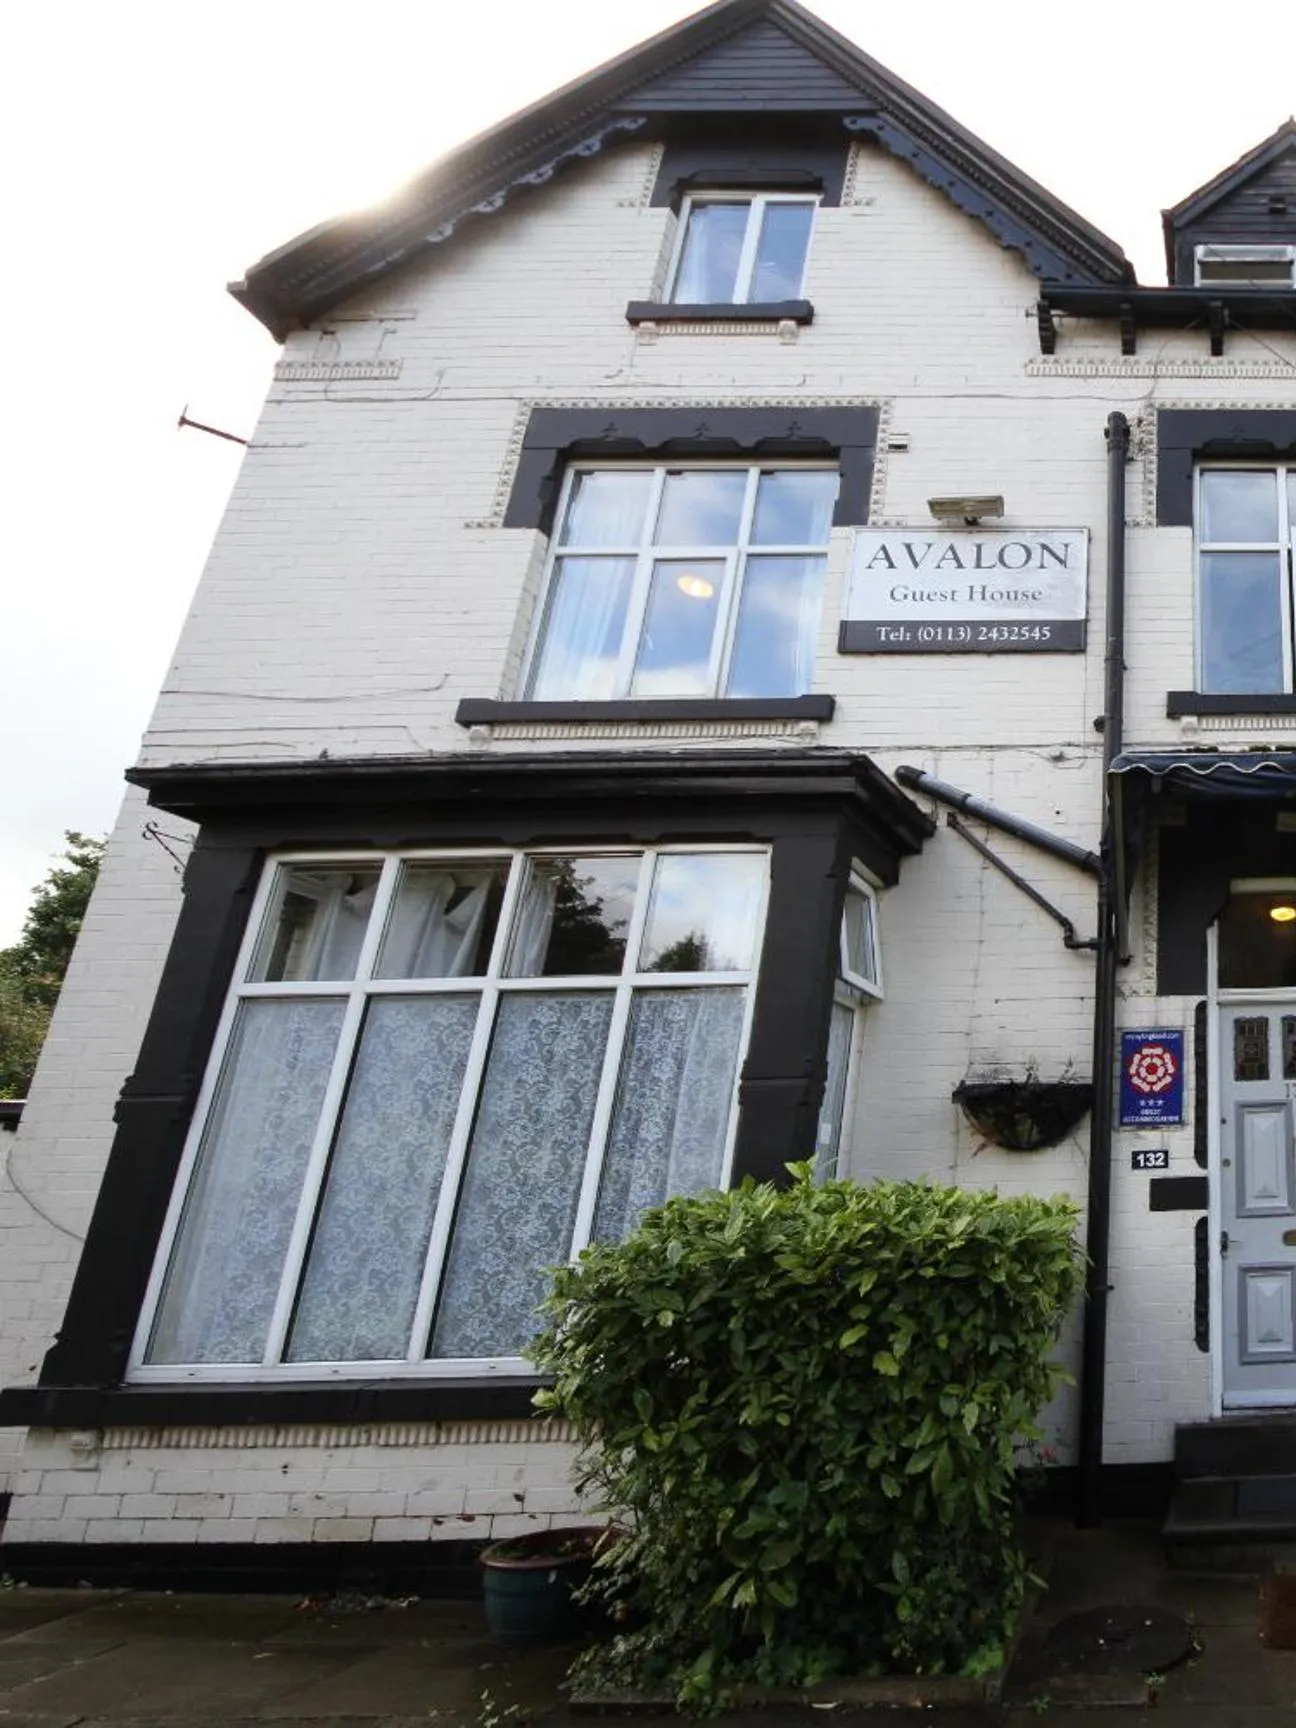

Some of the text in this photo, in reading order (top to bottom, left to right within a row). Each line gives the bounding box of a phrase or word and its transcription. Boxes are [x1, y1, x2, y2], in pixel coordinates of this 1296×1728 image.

[866, 542, 1072, 570] AVALON
[889, 585, 1043, 602] Guest House
[876, 625, 1051, 642] Tel: (0113) 2432545
[1136, 1152, 1165, 1168] 132
